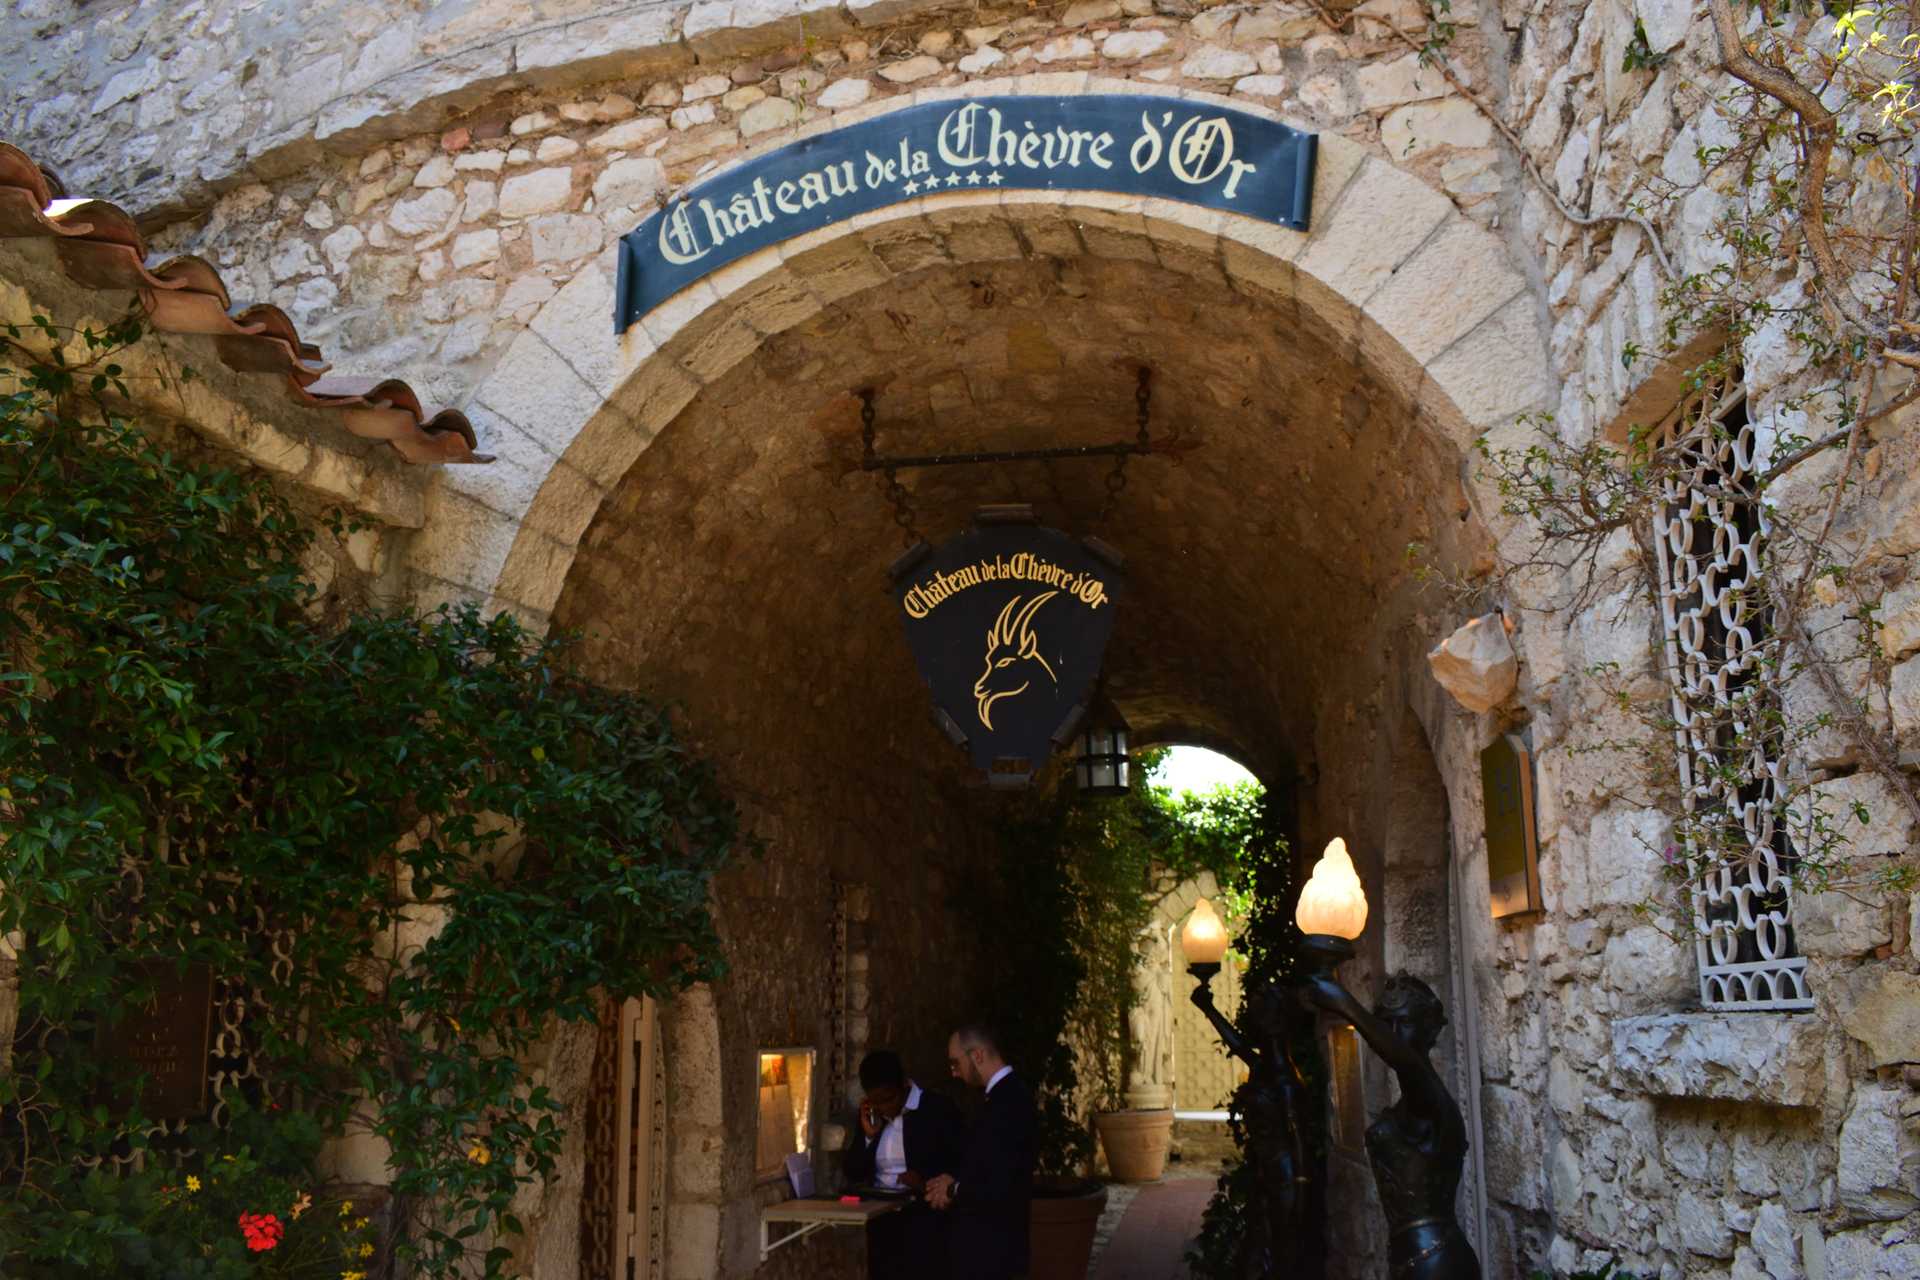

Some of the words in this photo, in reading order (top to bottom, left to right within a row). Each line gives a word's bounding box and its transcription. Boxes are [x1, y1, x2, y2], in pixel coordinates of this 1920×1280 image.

[659, 160, 859, 265] Château
[937, 102, 1114, 169] Chèvre
[1129, 109, 1257, 199] d'Or
[903, 564, 982, 619] Château
